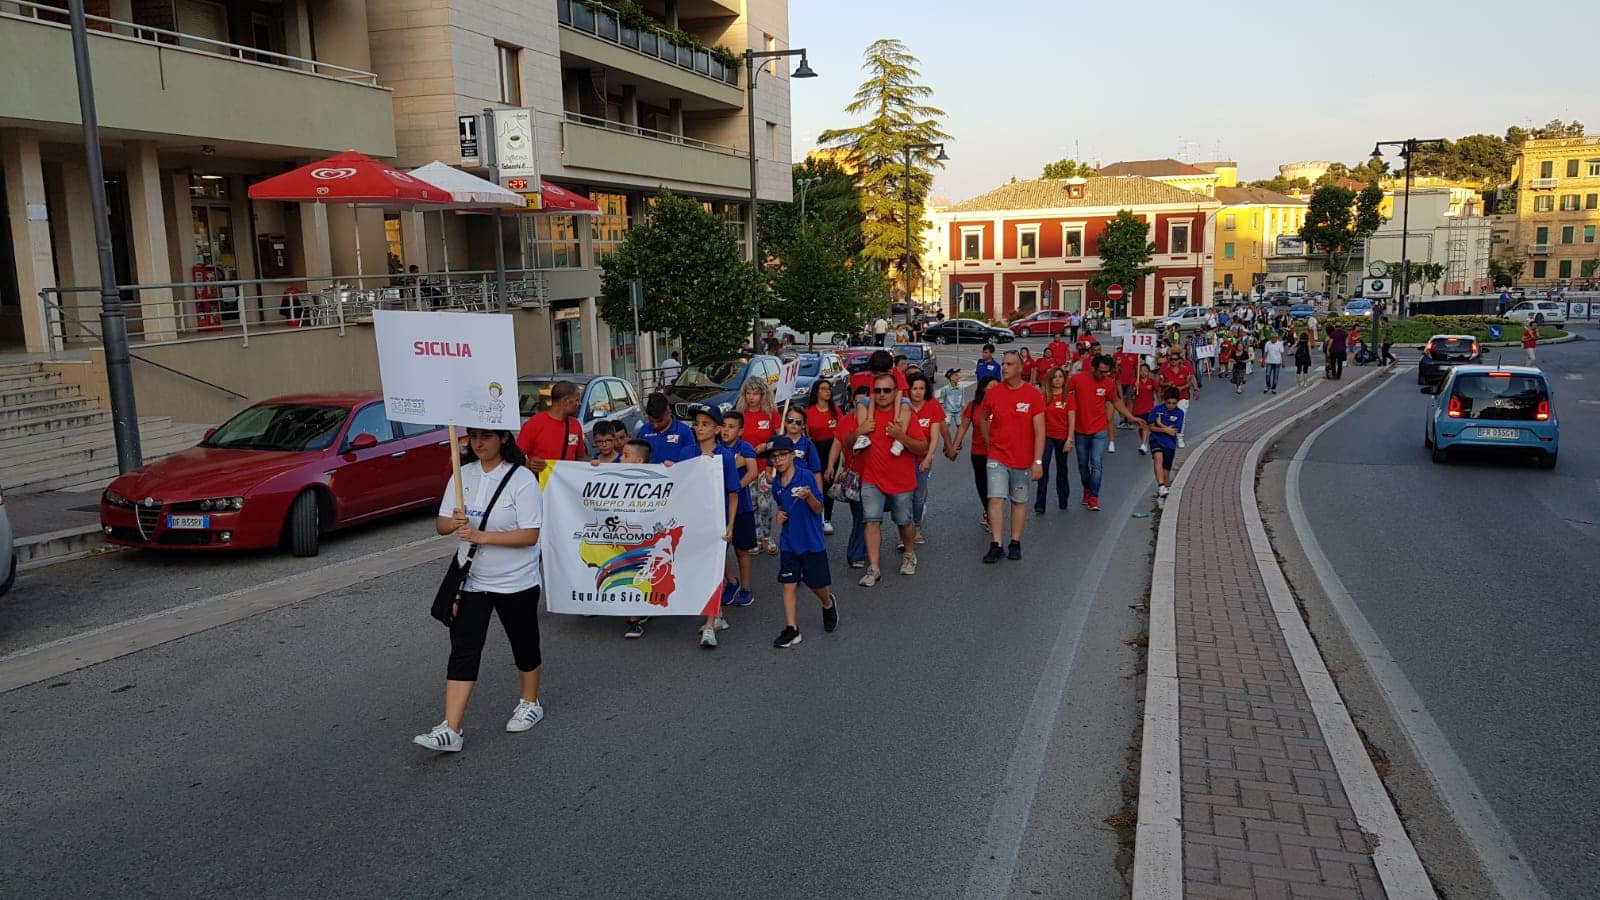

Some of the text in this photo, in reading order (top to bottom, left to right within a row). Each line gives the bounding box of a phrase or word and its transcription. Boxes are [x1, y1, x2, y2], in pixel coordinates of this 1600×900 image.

[414, 341, 472, 358] SICILIA
[582, 482, 674, 499] MULTICAR
[583, 499, 625, 508] GRUPPO
[573, 531, 654, 541] SAN GIACOMO
[571, 590, 668, 603] Equipe Sicilia
